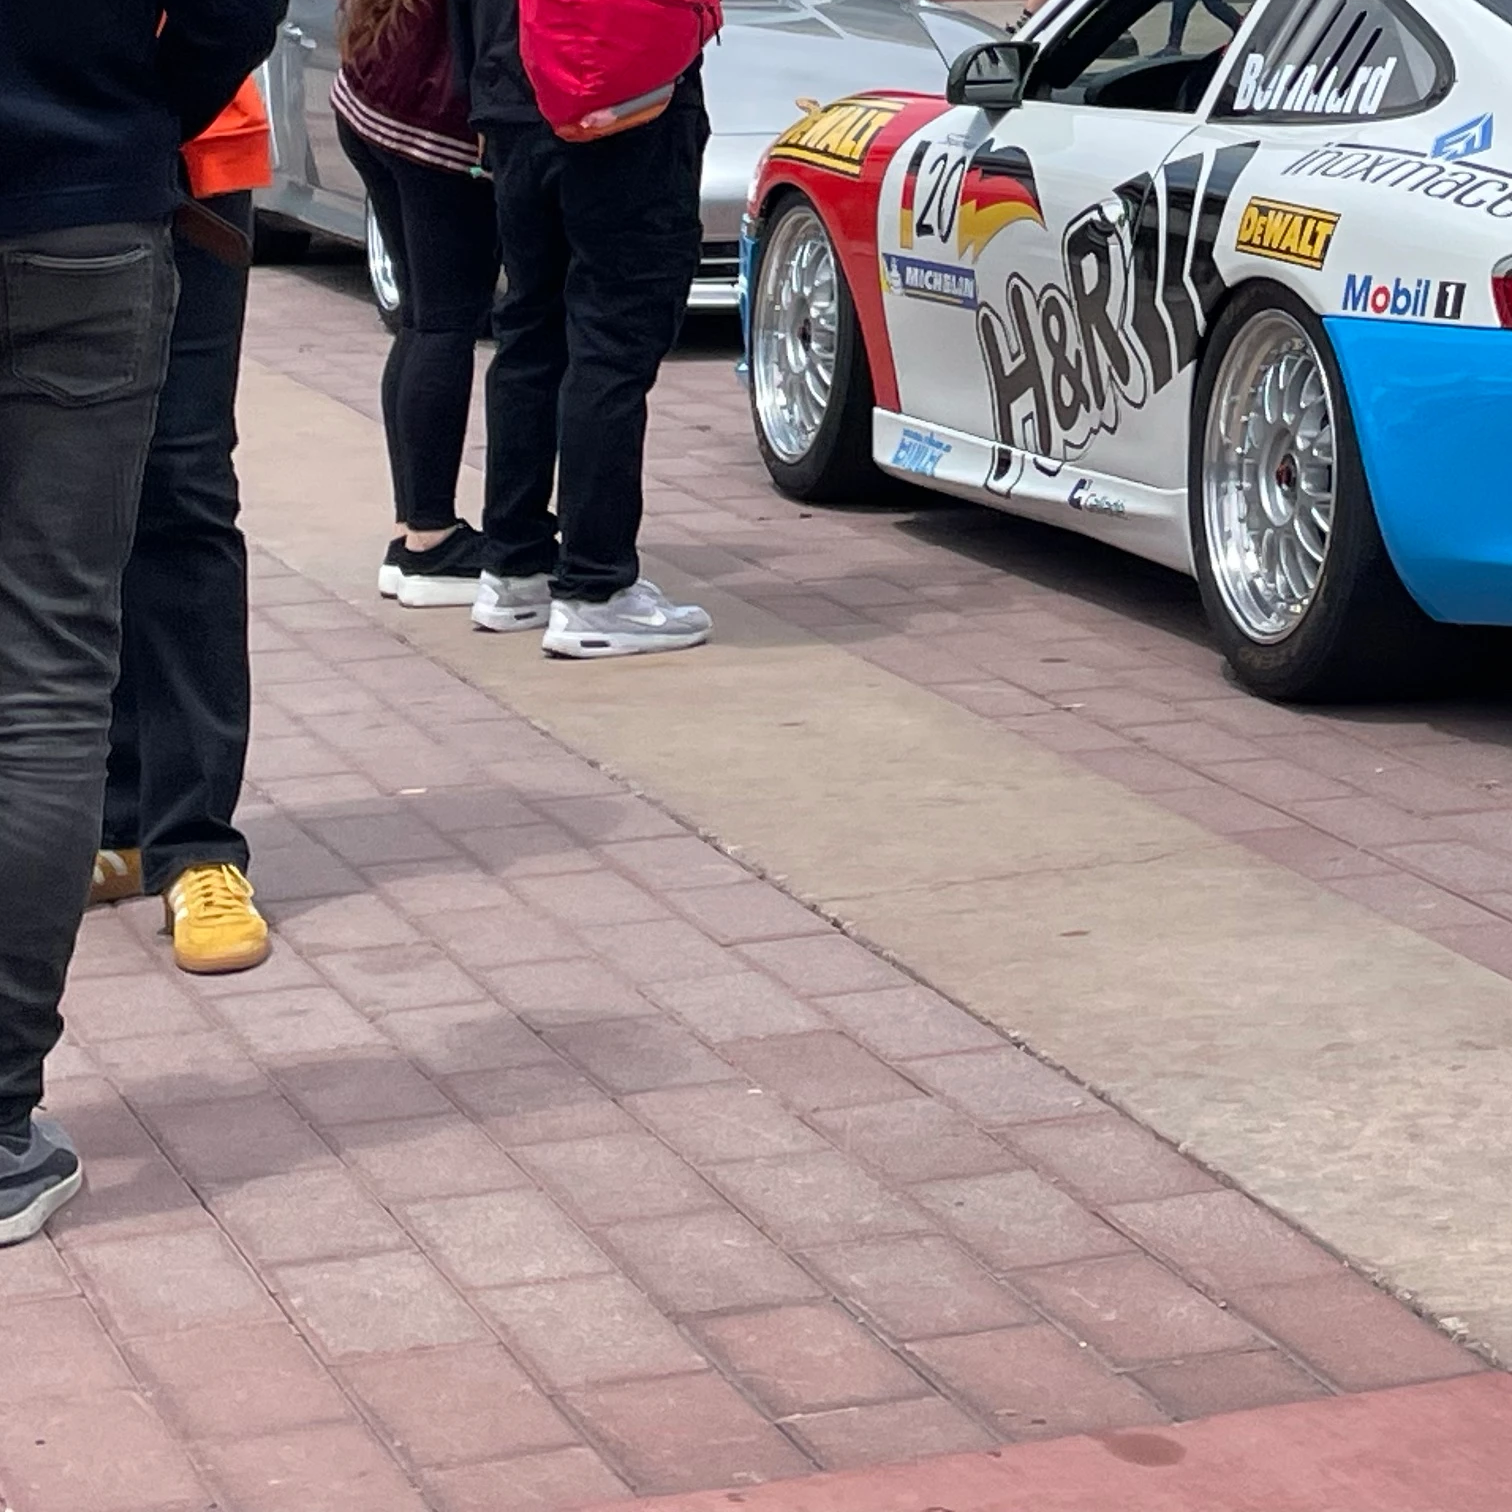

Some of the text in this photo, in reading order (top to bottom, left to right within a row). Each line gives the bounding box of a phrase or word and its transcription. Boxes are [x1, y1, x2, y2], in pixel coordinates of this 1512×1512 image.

[915, 152, 968, 244] 20
[904, 265, 976, 299] MICHELIN
[1341, 273, 1458, 317] Mobil 1
[976, 199, 1147, 497] H&R
